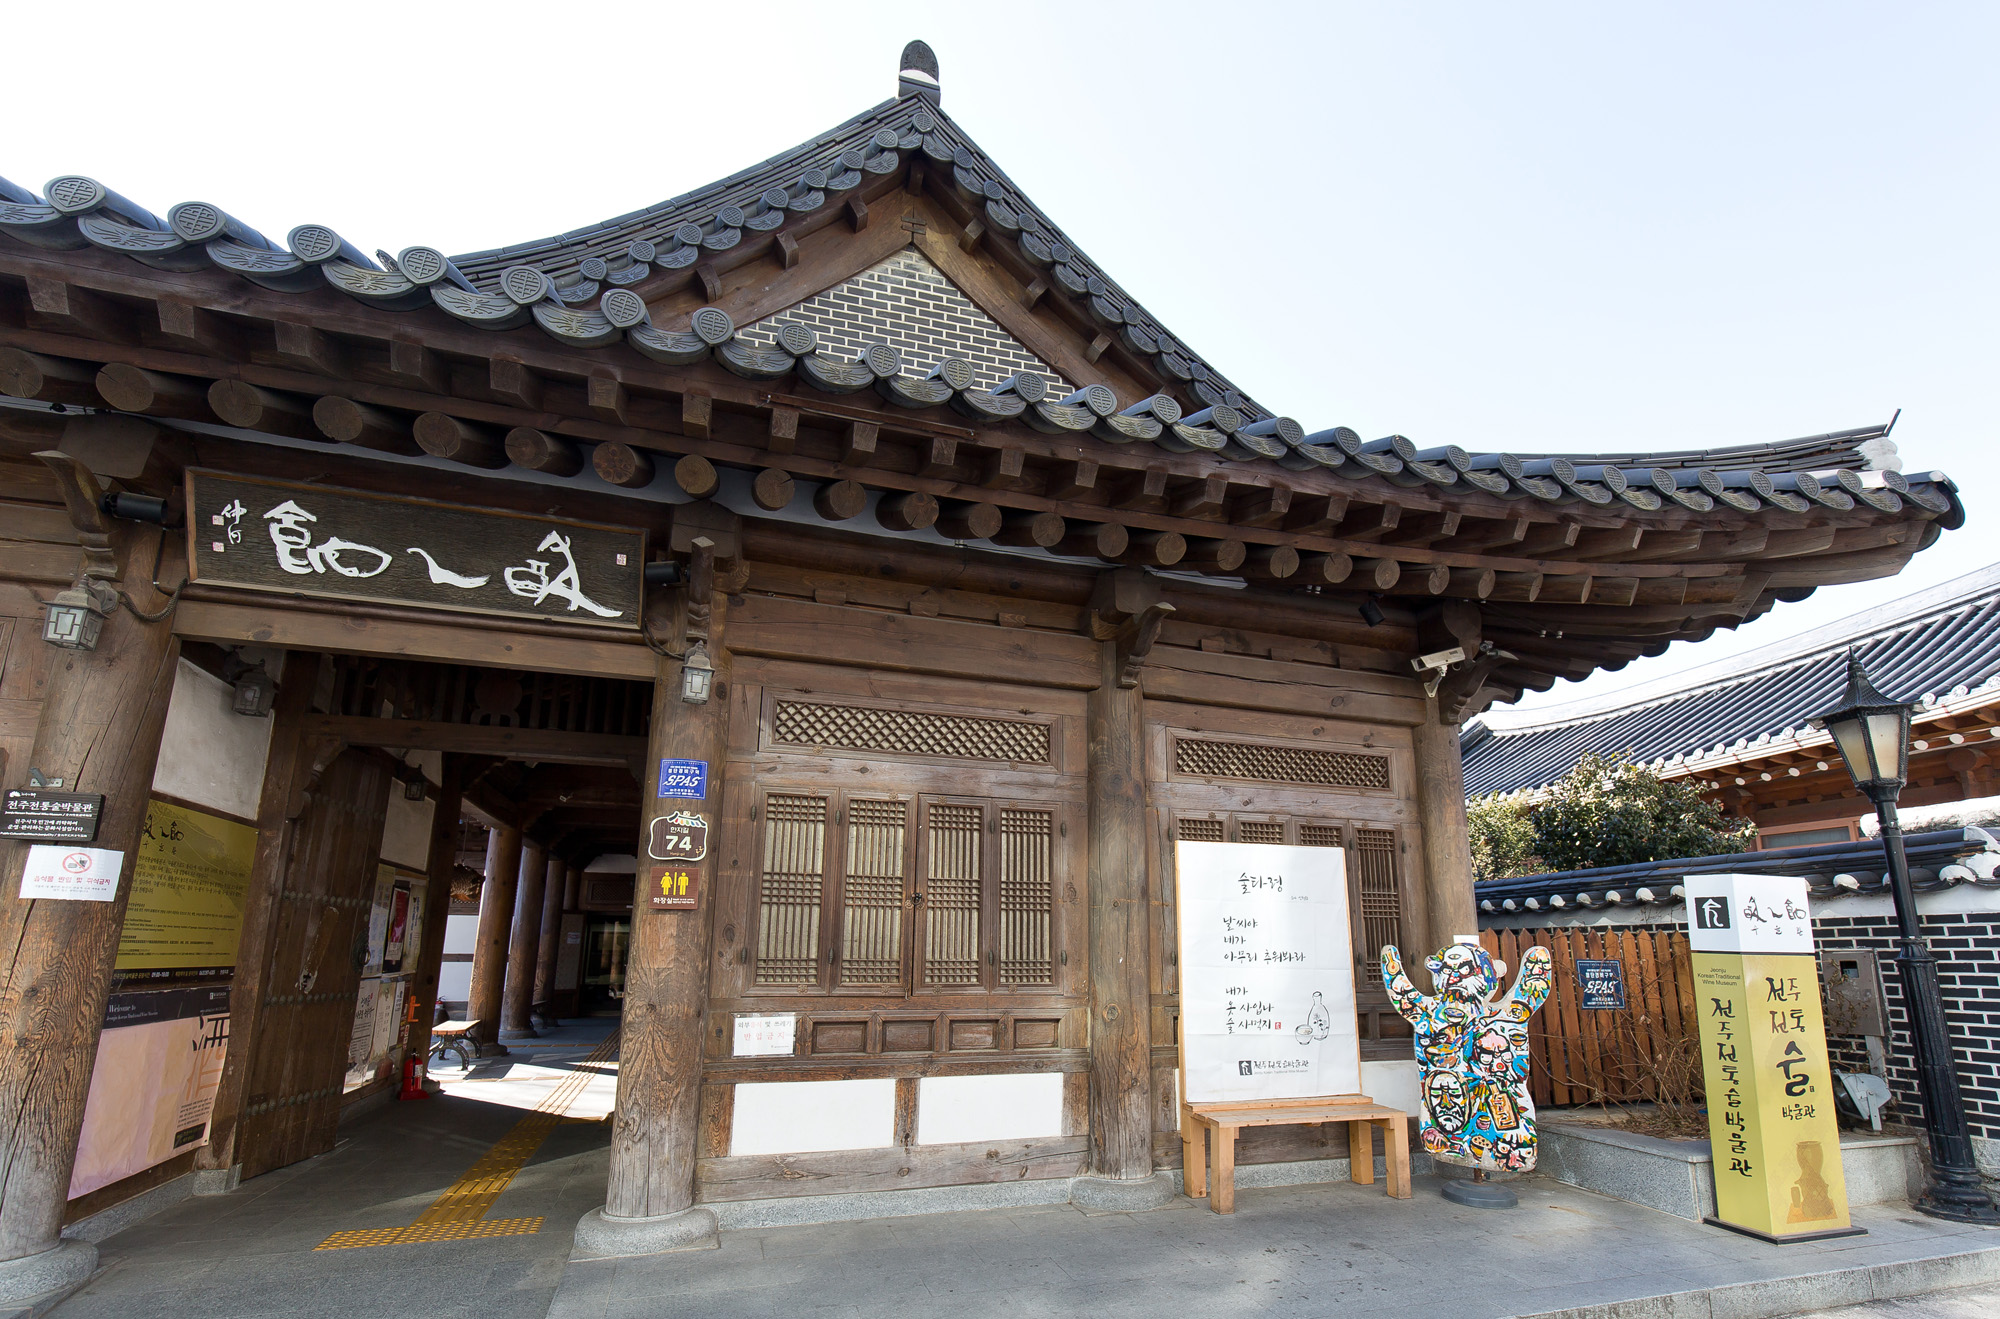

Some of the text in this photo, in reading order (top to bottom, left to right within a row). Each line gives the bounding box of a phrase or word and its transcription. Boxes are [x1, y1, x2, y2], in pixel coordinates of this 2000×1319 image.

[662, 775, 704, 787] SPAS
[7, 800, 94, 813] 전주전통술박물관
[665, 835, 692, 851] 74
[1238, 872, 1283, 895] 술타령
[1223, 916, 1258, 931] 날씨야
[1224, 935, 1246, 945] 네가
[1224, 949, 1306, 965] 아무리 추워봐라
[1225, 986, 1249, 996] 내가
[1584, 980, 1619, 994] SPAS
[1765, 977, 1801, 1002] 전주
[1226, 1000, 1275, 1016] 옷 사입나
[1226, 1017, 1235, 1034] 술
[1238, 1018, 1271, 1031] 사먹지
[1769, 1009, 1806, 1033] 전통
[1776, 1040, 1810, 1097] 술
[1710, 998, 1752, 1177] 전주전통술박물관
[1782, 1103, 1816, 1121] 박물관
